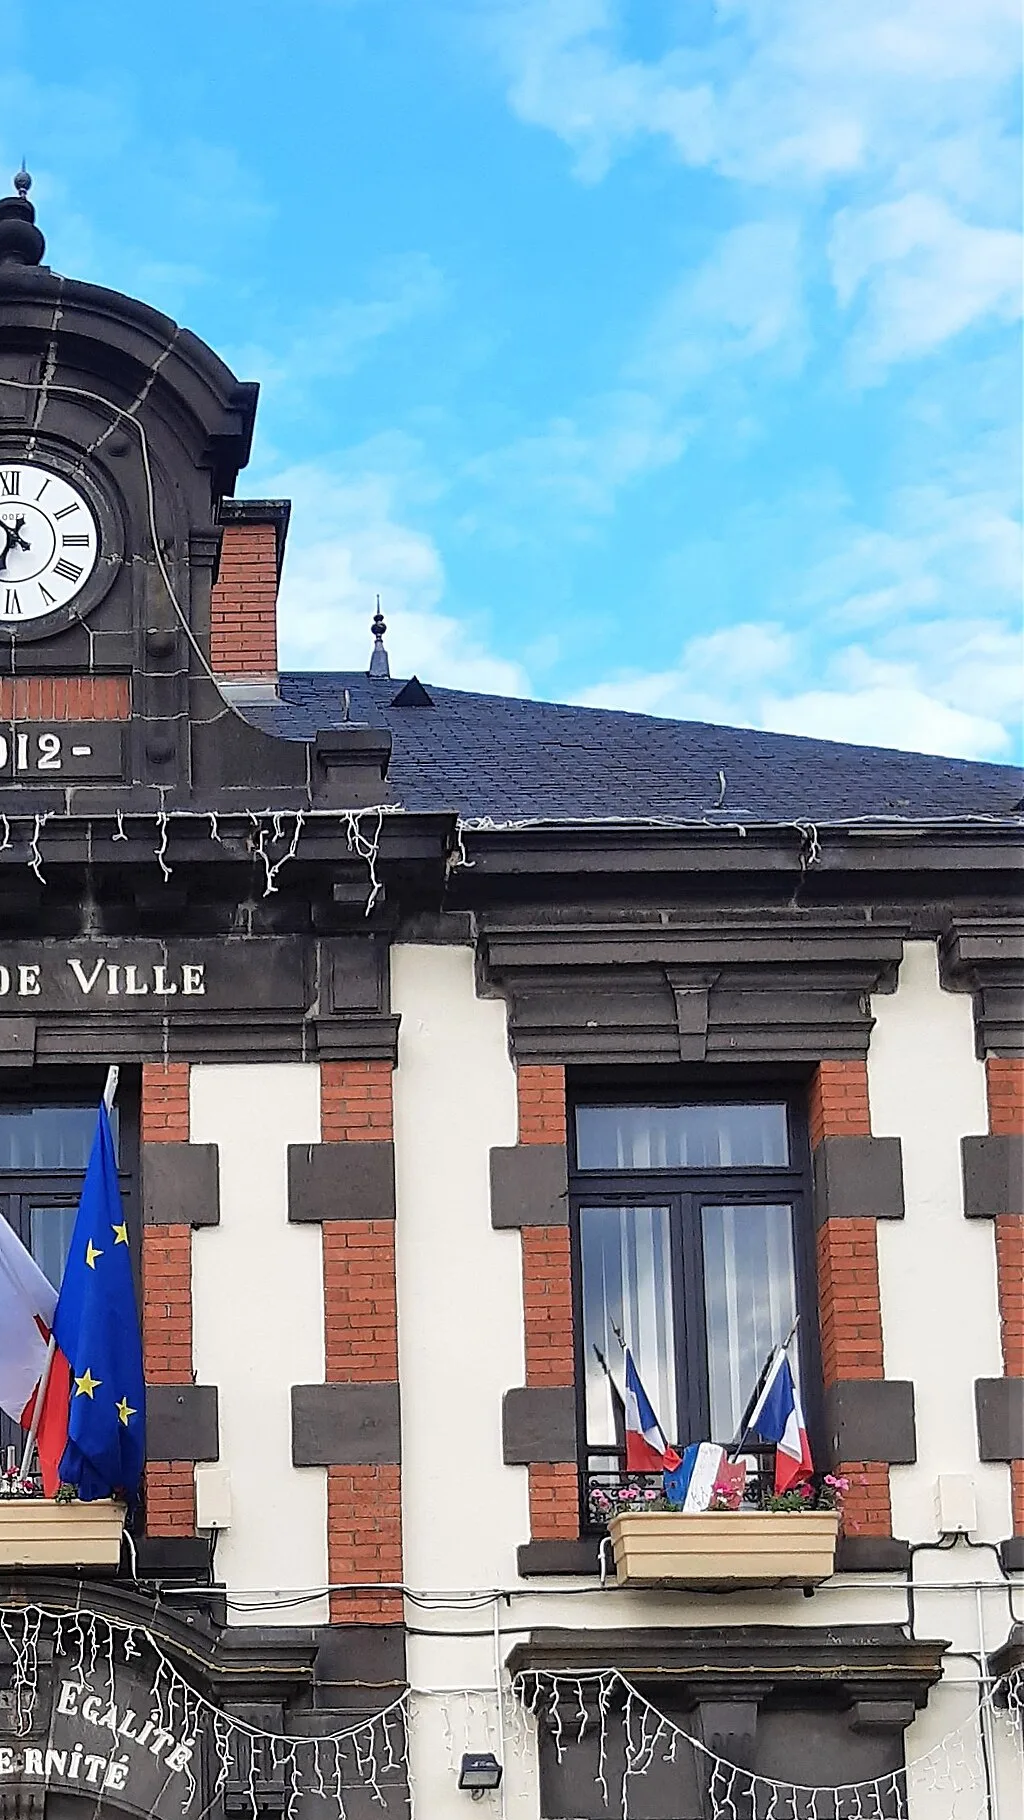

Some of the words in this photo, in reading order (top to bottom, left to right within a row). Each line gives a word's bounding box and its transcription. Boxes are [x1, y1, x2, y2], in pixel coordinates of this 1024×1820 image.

[36, 478, 51, 501] I
[53, 502, 81, 520] II
[62, 534, 89, 548] III
[53, 558, 83, 584] IIII
[3, 589, 23, 614] VI
[38, 582, 57, 606] V
[67, 958, 206, 995] VILLE
